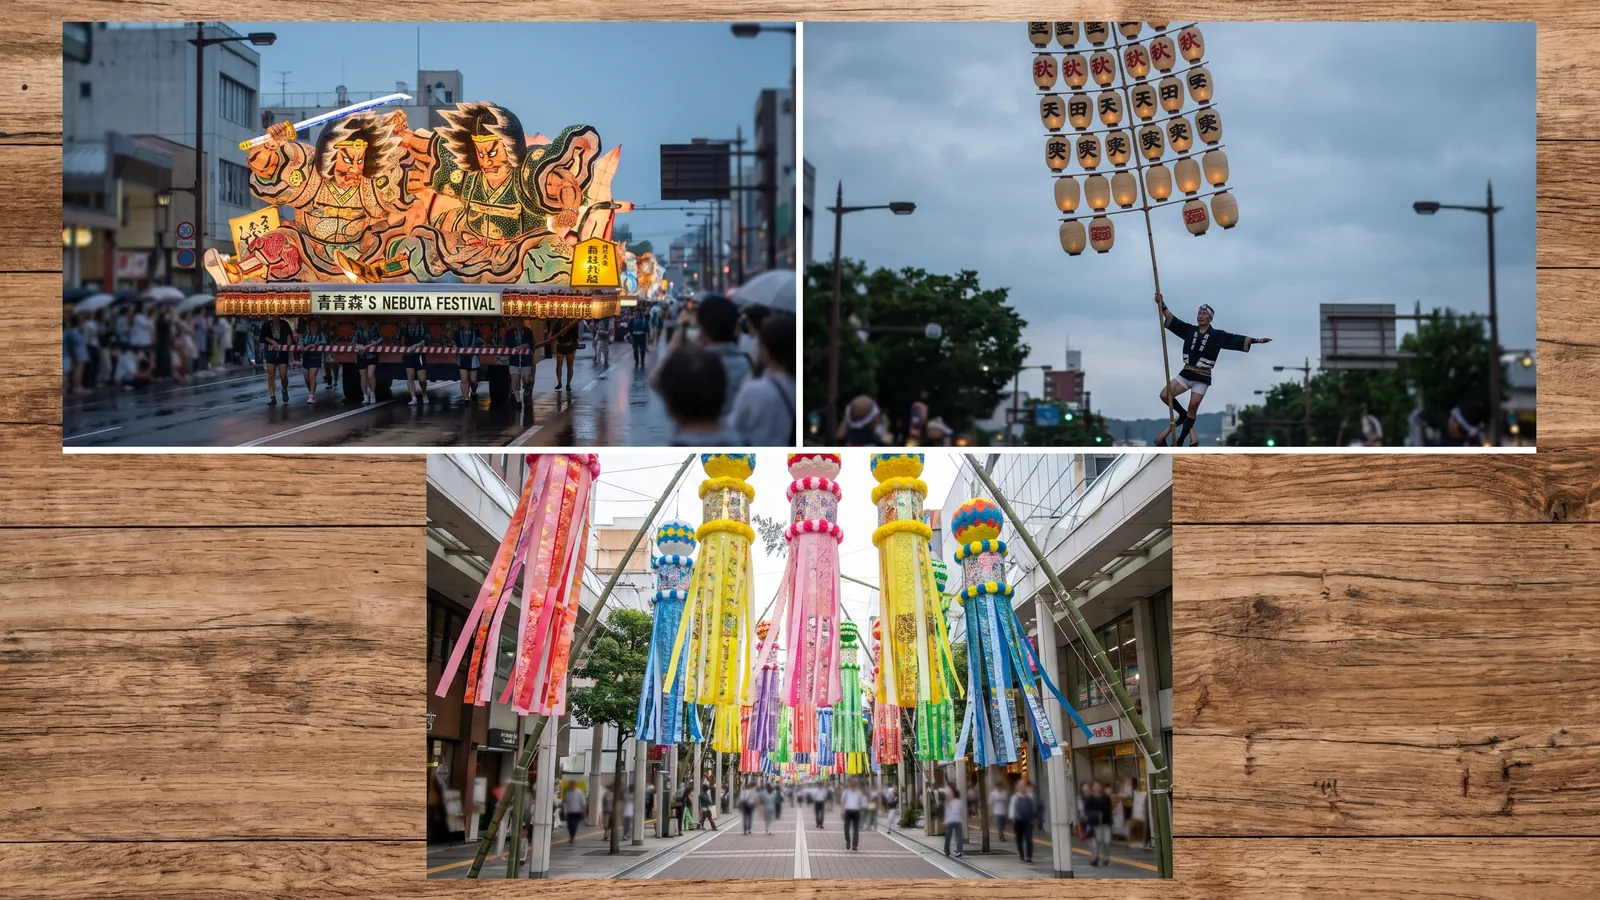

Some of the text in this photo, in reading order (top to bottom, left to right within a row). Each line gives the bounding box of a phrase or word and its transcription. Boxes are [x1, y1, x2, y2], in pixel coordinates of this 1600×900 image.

[1179, 31, 1201, 52] 秋
[1126, 49, 1147, 69] 秋
[1150, 41, 1172, 61] 秋
[1034, 60, 1054, 78] 秋
[1063, 59, 1083, 78] 秋
[1092, 56, 1112, 75] 秋
[1135, 90, 1153, 108] 天
[1161, 84, 1179, 101] 田
[1043, 102, 1061, 119] 天
[1070, 101, 1088, 118] 田
[1100, 97, 1118, 115] 天
[180, 226, 192, 235] 30
[382, 295, 432, 311] NEBUTA
[436, 296, 496, 311] FESTIVAL
